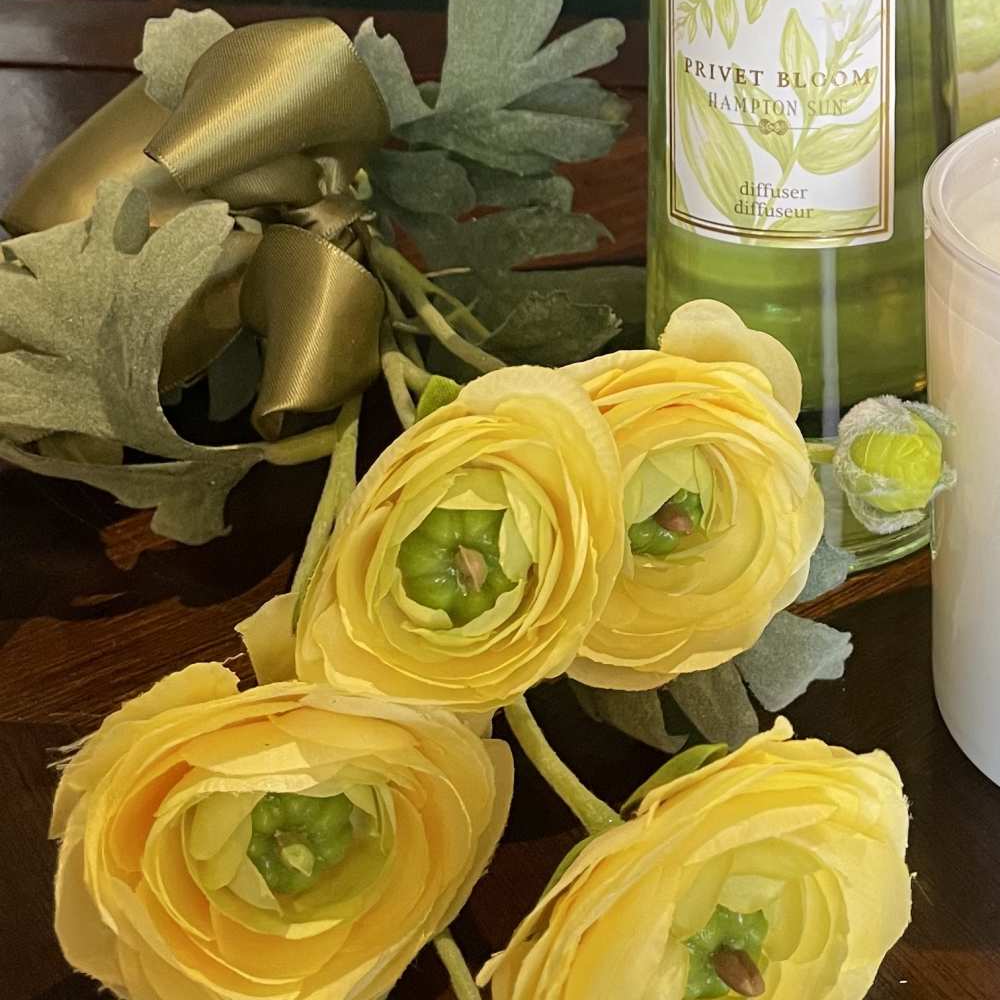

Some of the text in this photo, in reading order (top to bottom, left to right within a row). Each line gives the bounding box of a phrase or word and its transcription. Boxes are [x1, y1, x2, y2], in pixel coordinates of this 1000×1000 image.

[684, 56, 871, 88] PRIVET BLOOM
[708, 92, 798, 116] HAMPTON
[739, 180, 808, 199] diffuser
[734, 200, 814, 219] diffuseur
